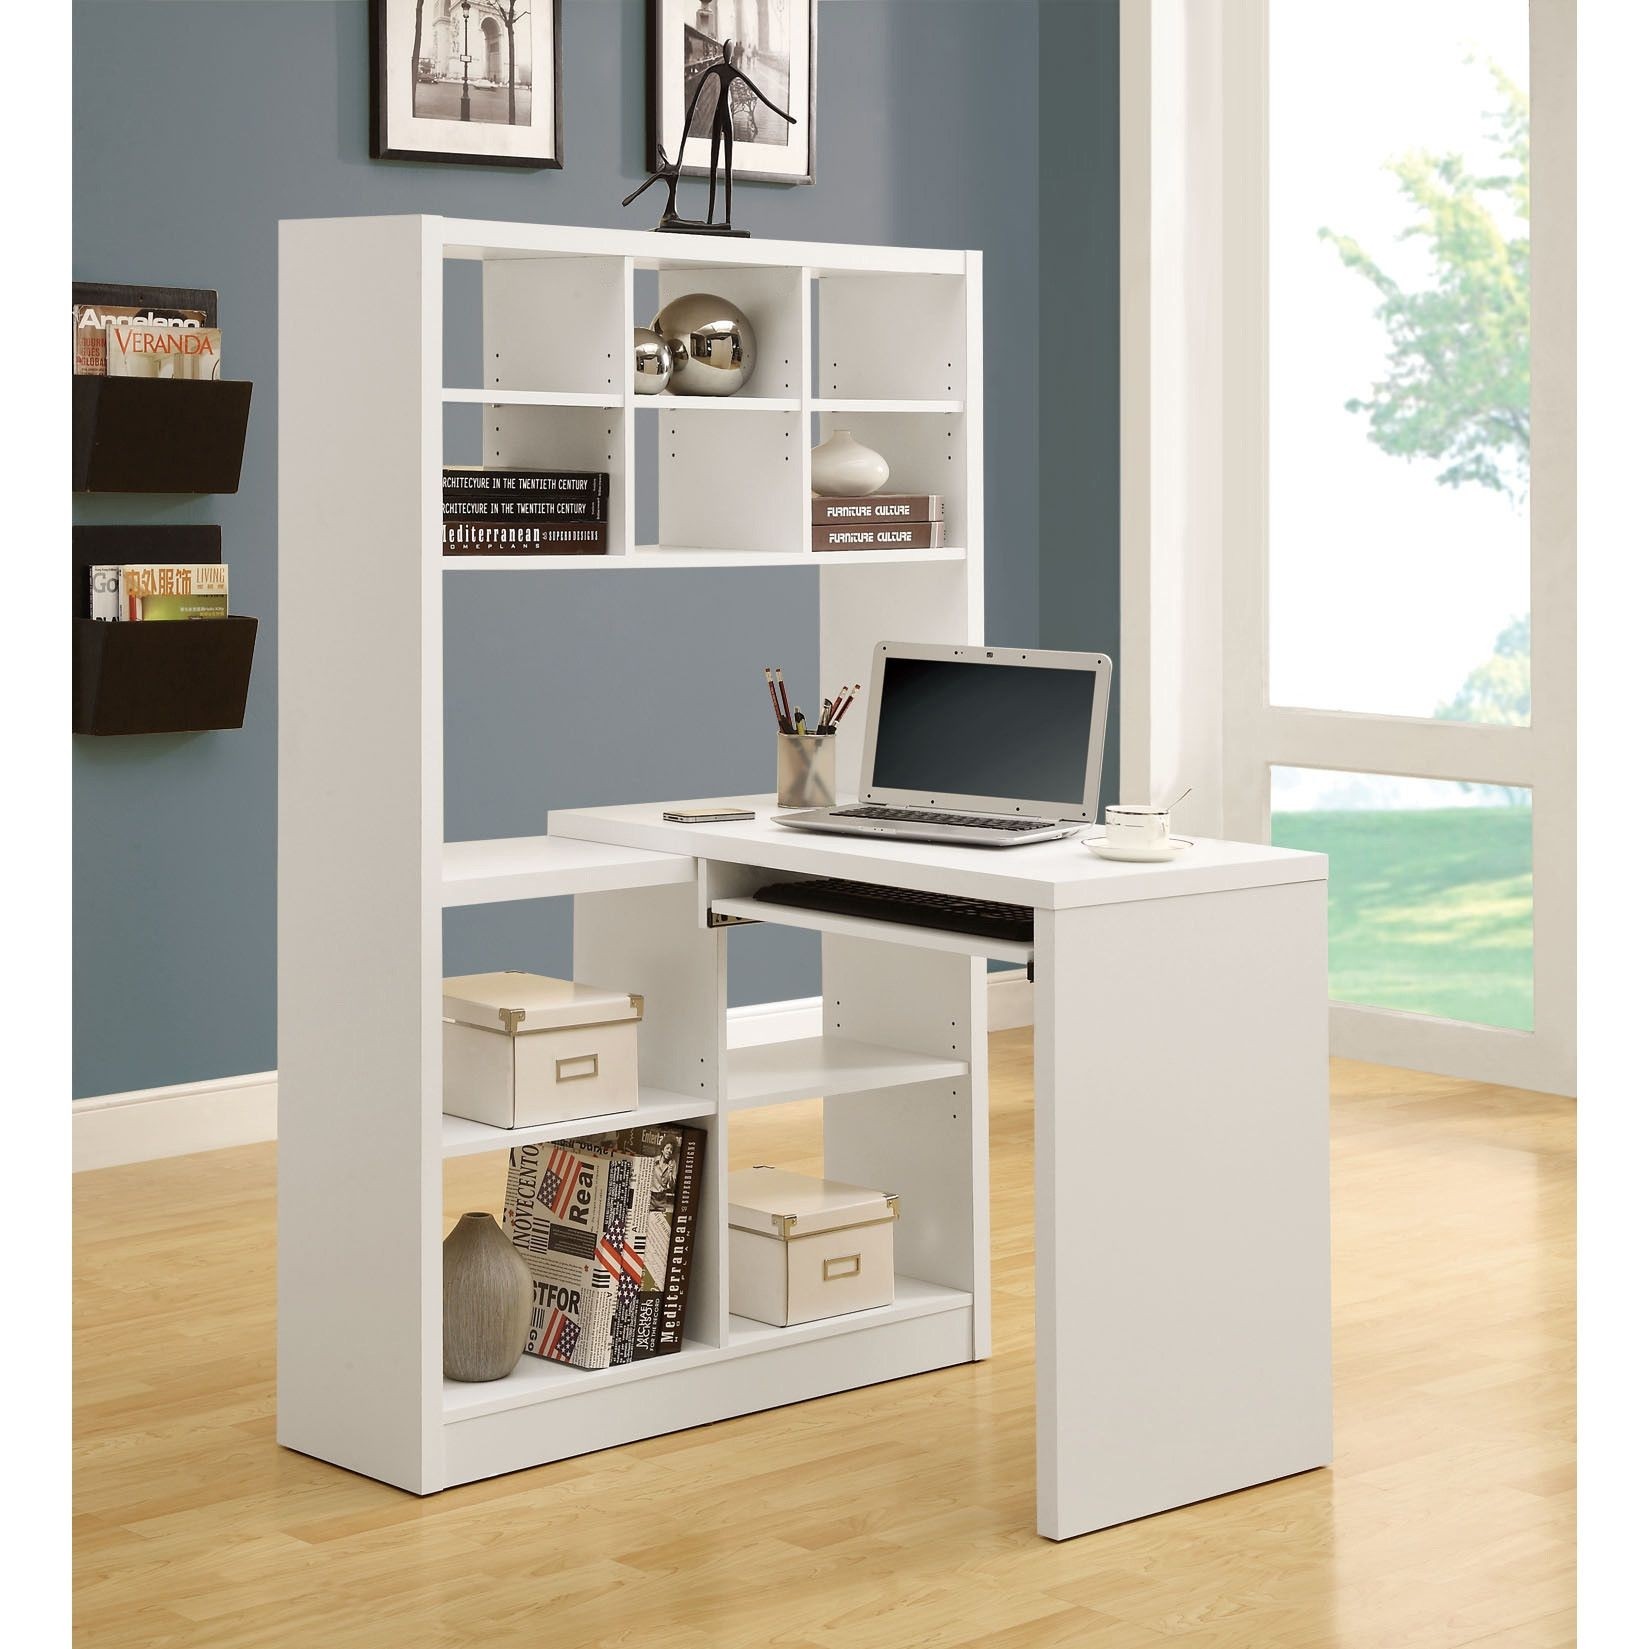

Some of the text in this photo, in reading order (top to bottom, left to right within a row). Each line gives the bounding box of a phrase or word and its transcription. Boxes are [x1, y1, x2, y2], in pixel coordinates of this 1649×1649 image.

[114, 328, 214, 356] VERANDA
[492, 477, 501, 489] IN
[503, 478, 516, 490] THE
[518, 478, 557, 491] TWENTIETH
[558, 479, 588, 491] CENTURY
[490, 502, 499, 515] IN
[501, 502, 515, 515] THE
[516, 503, 555, 515] TWENTIETH
[556, 503, 587, 515] CENTURY
[827, 505, 910, 518] FURNITURE CULTURE
[829, 531, 912, 544] FURNITURE CULTURE
[196, 567, 225, 583] LIVING
[568, 1161, 595, 1226] Real
[660, 1215, 688, 1343] Mediterranean
[635, 1301, 648, 1348] MICHAEL
[642, 1299, 654, 1350] JACKSON
